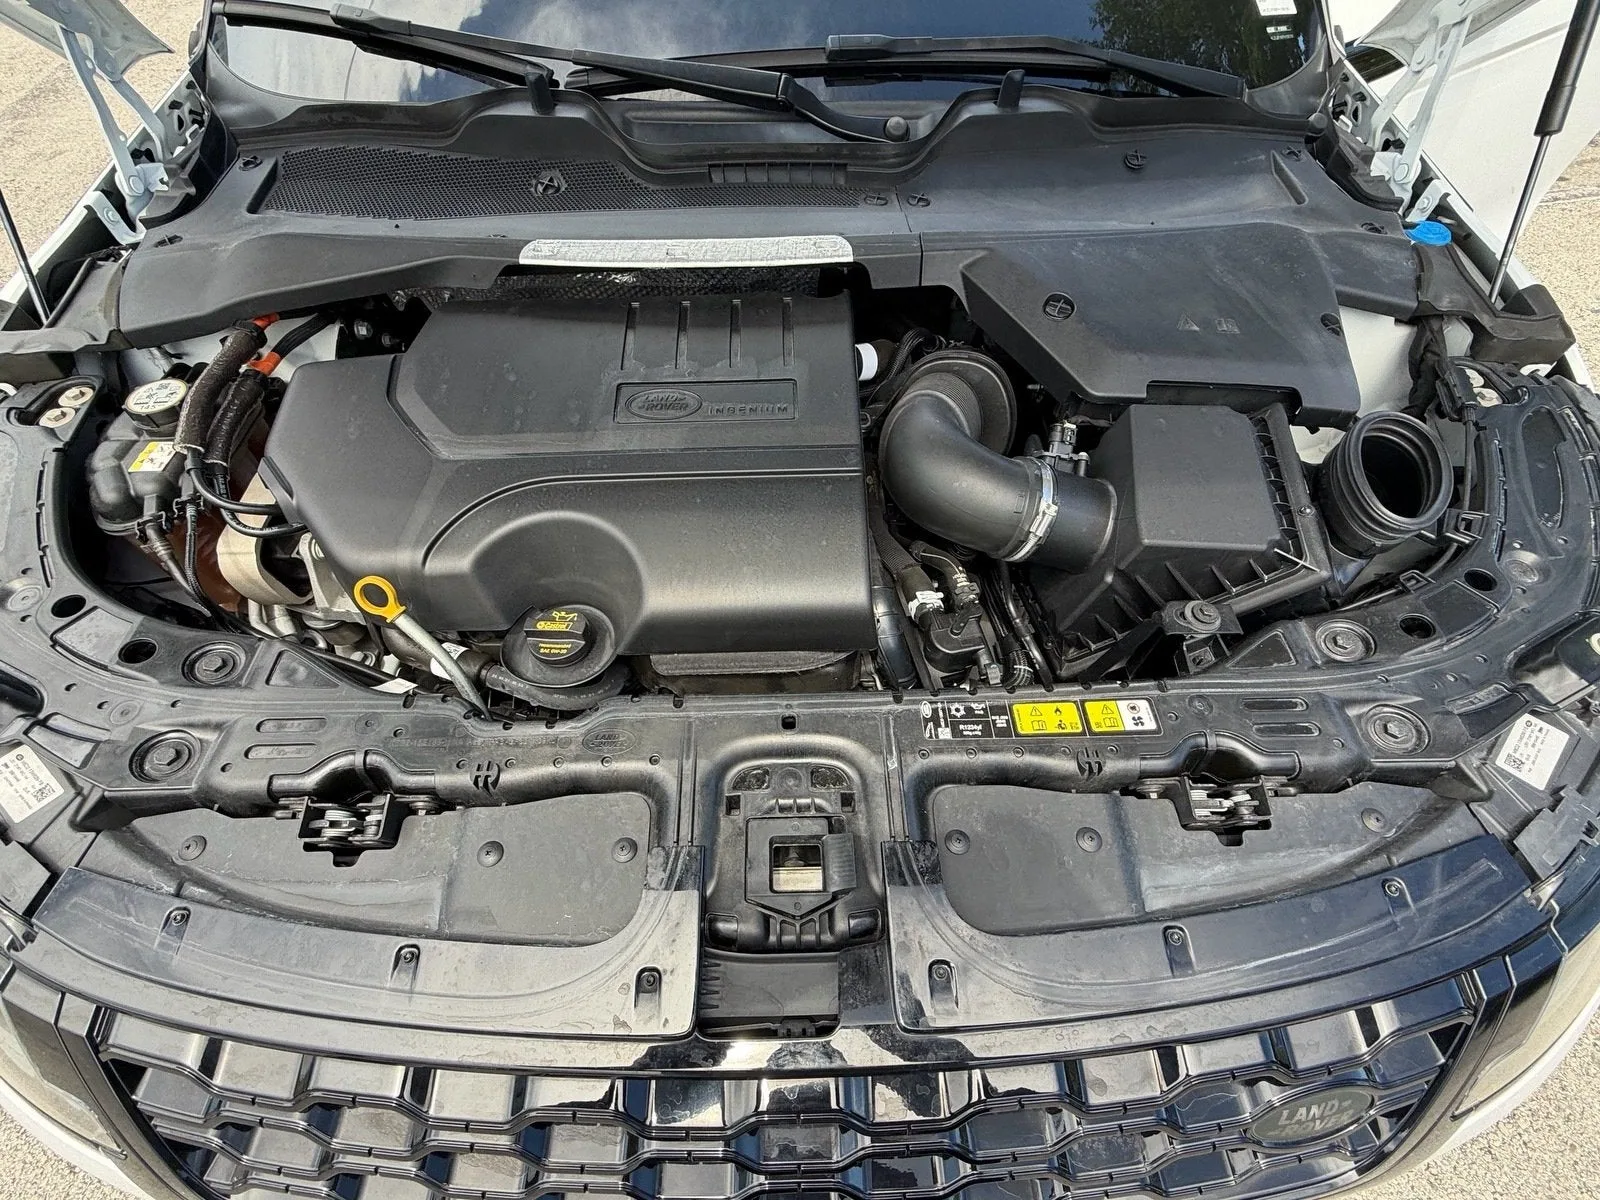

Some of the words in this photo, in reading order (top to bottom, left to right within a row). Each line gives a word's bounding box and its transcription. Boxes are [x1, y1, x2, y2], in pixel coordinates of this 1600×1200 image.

[644, 393, 681, 402] LAND
[645, 402, 689, 411] ROVER
[708, 404, 788, 416] INGENIUM
[1278, 1099, 1340, 1125] LAND
[1284, 1109, 1354, 1136] ROVER
